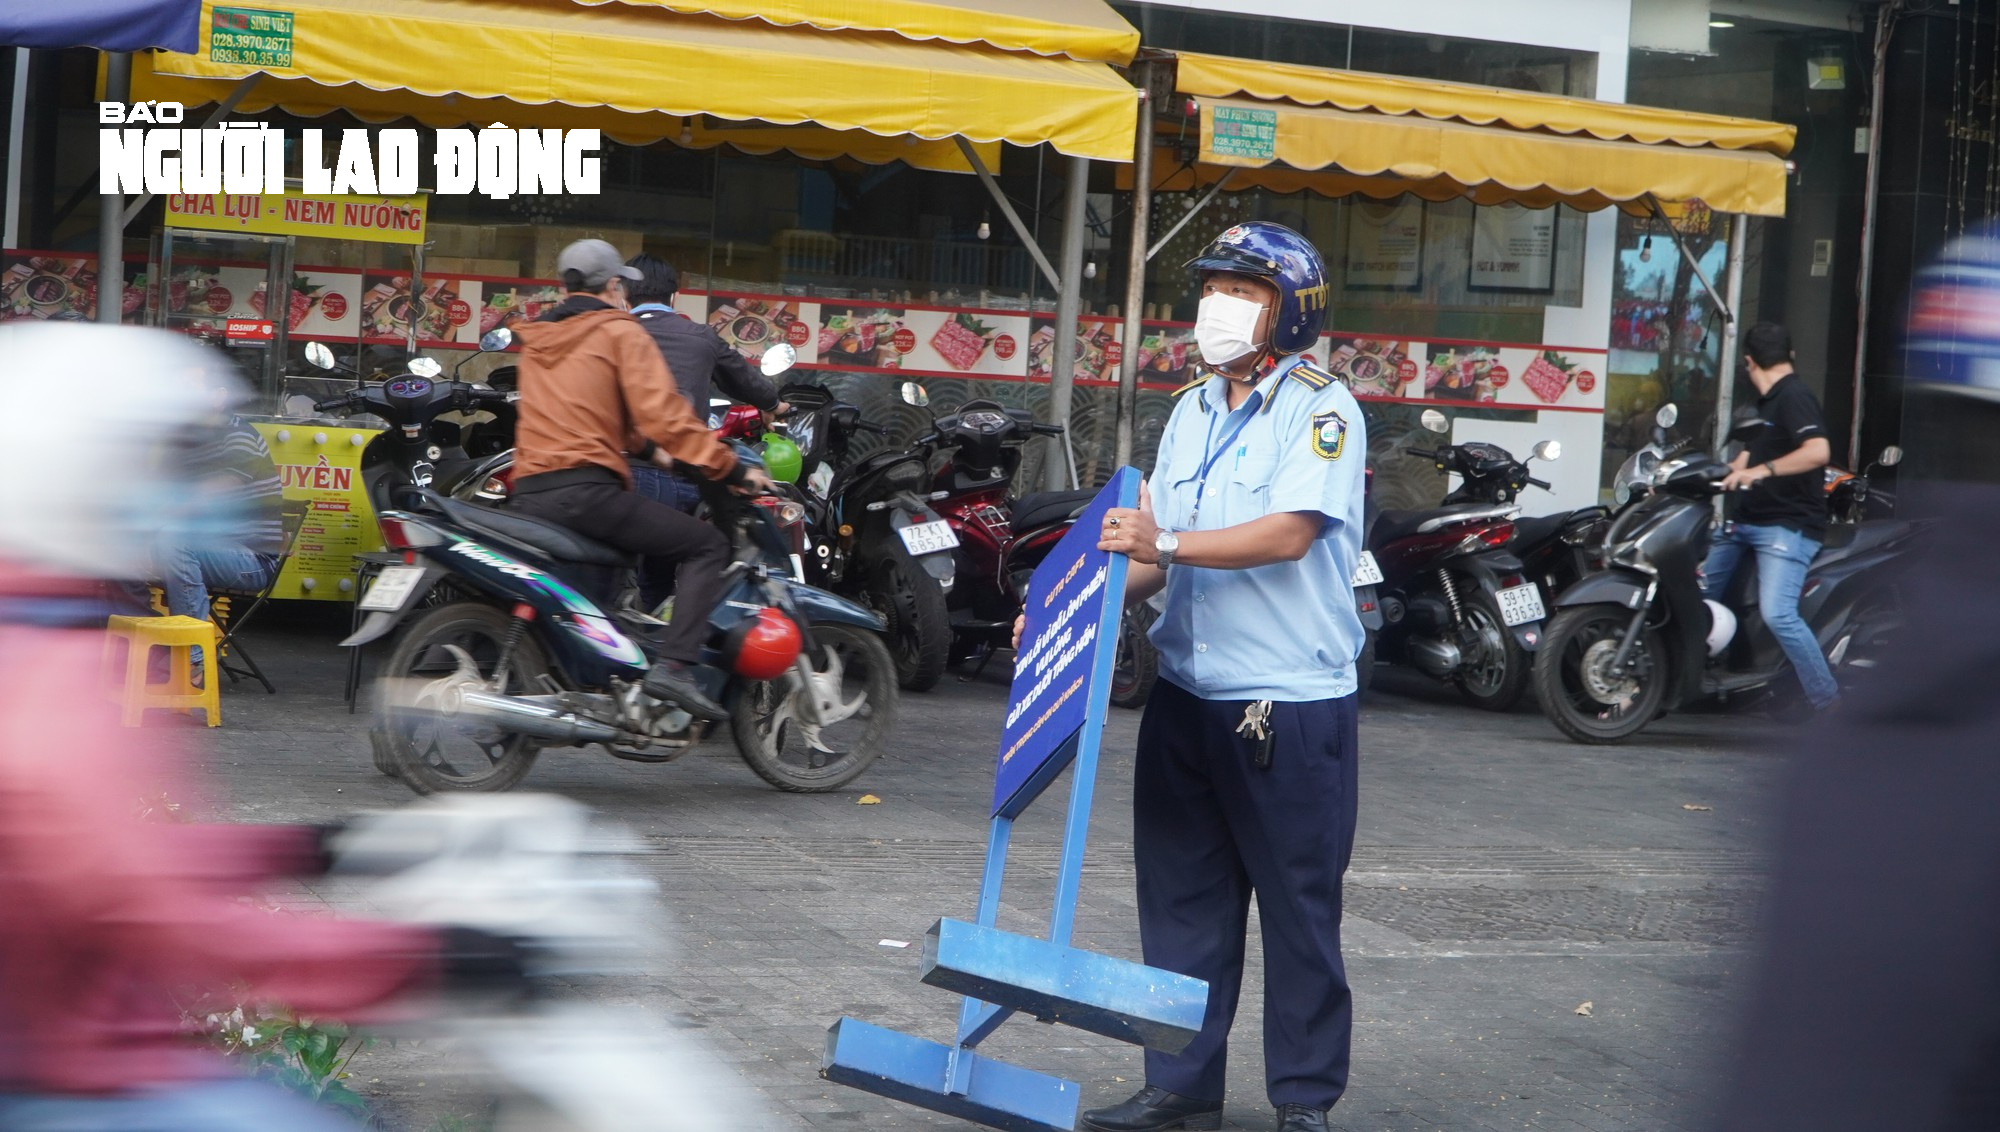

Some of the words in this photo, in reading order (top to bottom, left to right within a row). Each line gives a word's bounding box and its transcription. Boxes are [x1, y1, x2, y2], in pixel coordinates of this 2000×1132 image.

[251, 15, 270, 31] SINH
[272, 14, 291, 34] VIỆT
[212, 33, 291, 52] 028.3970.2671
[212, 48, 291, 66] 0938.30.35.99
[1214, 136, 1273, 150] 028.3970.2671
[224, 194, 261, 225] LỤI
[284, 198, 336, 225] NEM
[343, 200, 422, 231] NƯỚNG
[452, 304, 467, 312] BBQ
[229, 323, 258, 332] LOSHIP
[791, 325, 806, 333] BBQ
[907, 523, 943, 539] 72-K1
[909, 534, 955, 552] 685.21
[1044, 578, 1065, 608] GUTA
[1503, 587, 1533, 607] 59-F1
[1505, 602, 1542, 623] 936.58
